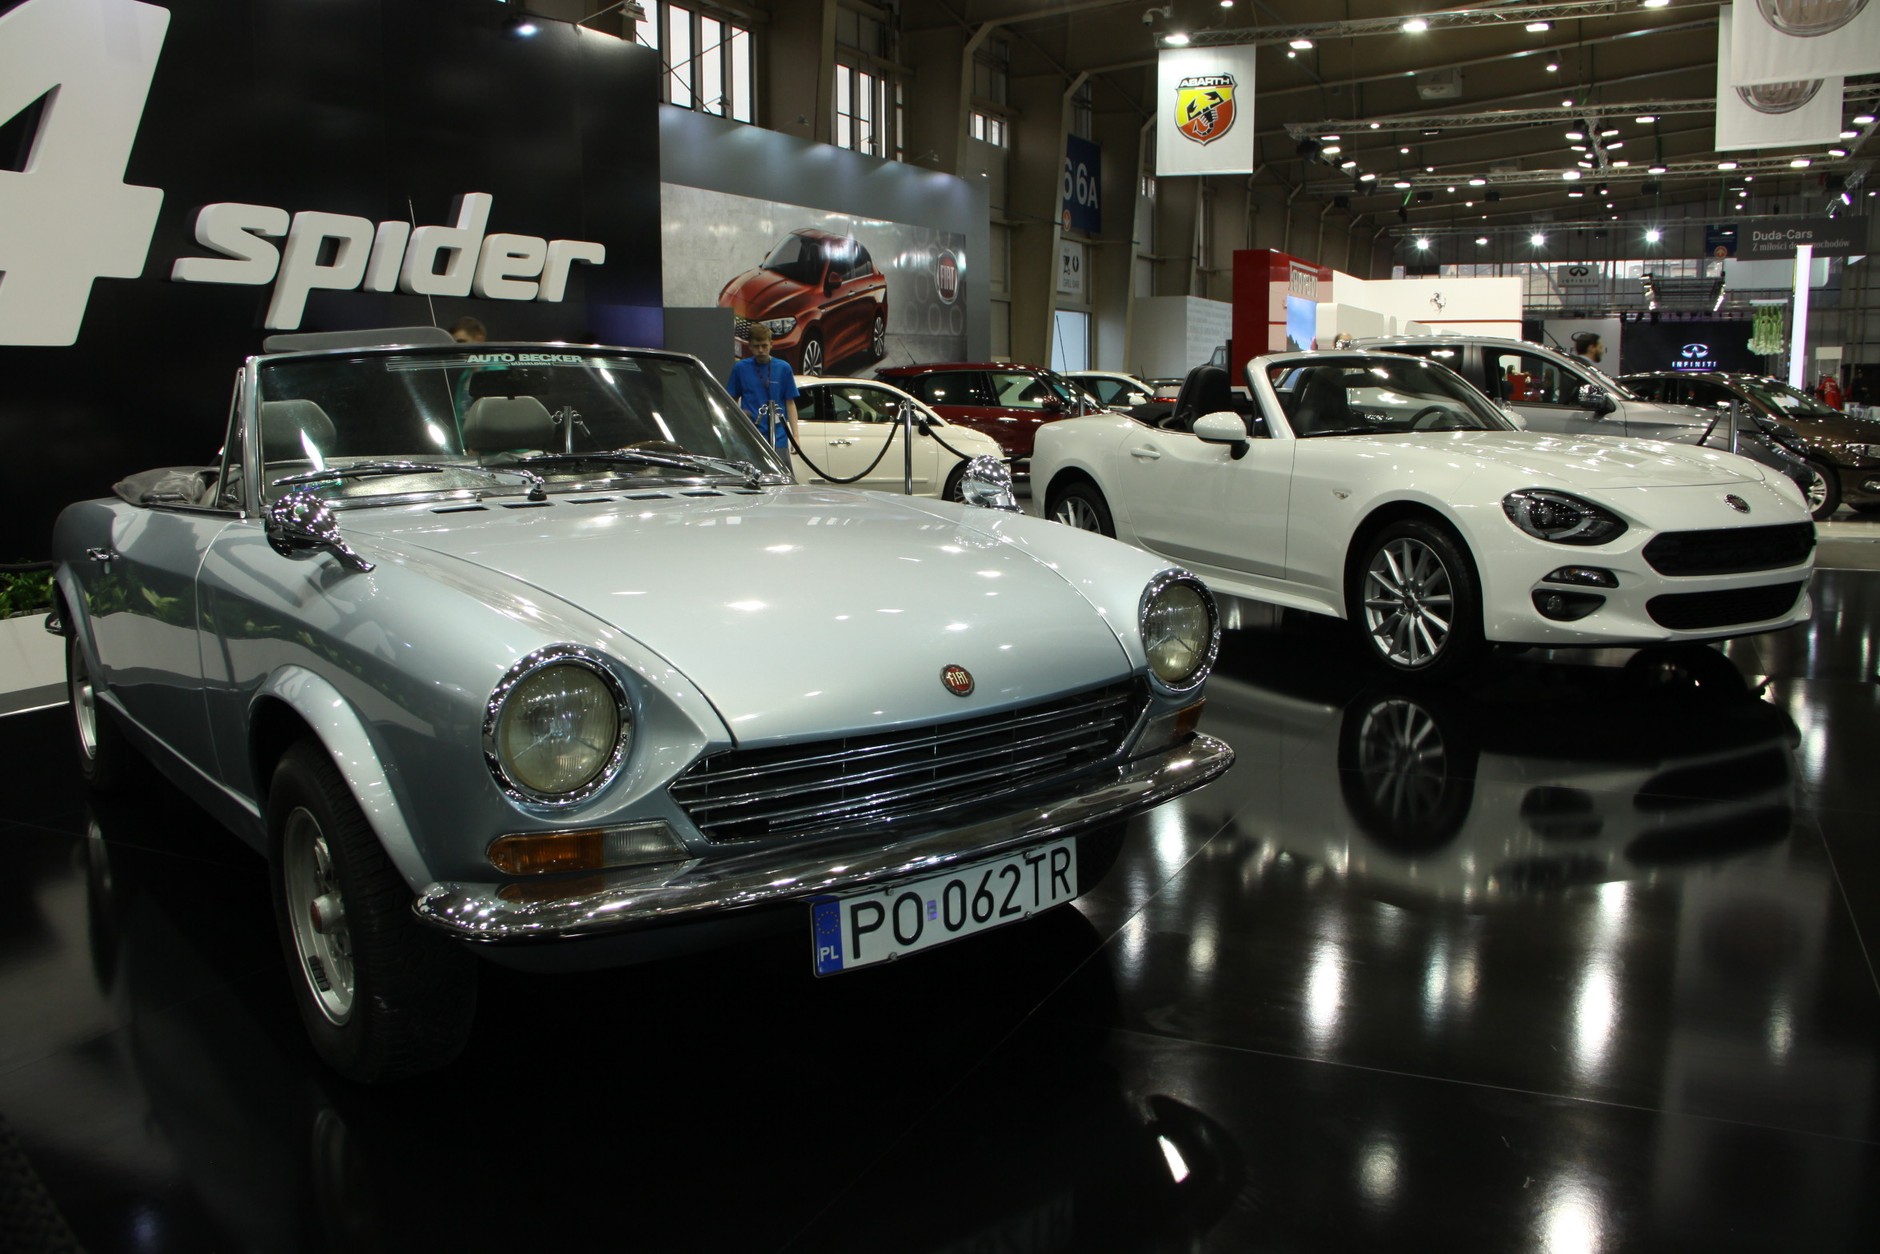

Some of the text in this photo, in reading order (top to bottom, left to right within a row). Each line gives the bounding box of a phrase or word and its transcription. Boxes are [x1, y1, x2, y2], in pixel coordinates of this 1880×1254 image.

[1180, 77, 1230, 87] ABARTH
[1076, 162, 1099, 209] 6A
[1752, 229, 1813, 241] Duda-Cars
[171, 192, 605, 329] spider
[940, 264, 955, 290] FIAT
[467, 353, 584, 363] AUTO BECKER
[946, 671, 969, 686] FIAT
[850, 846, 1072, 960] PO 062TR
[819, 946, 839, 962] PL
